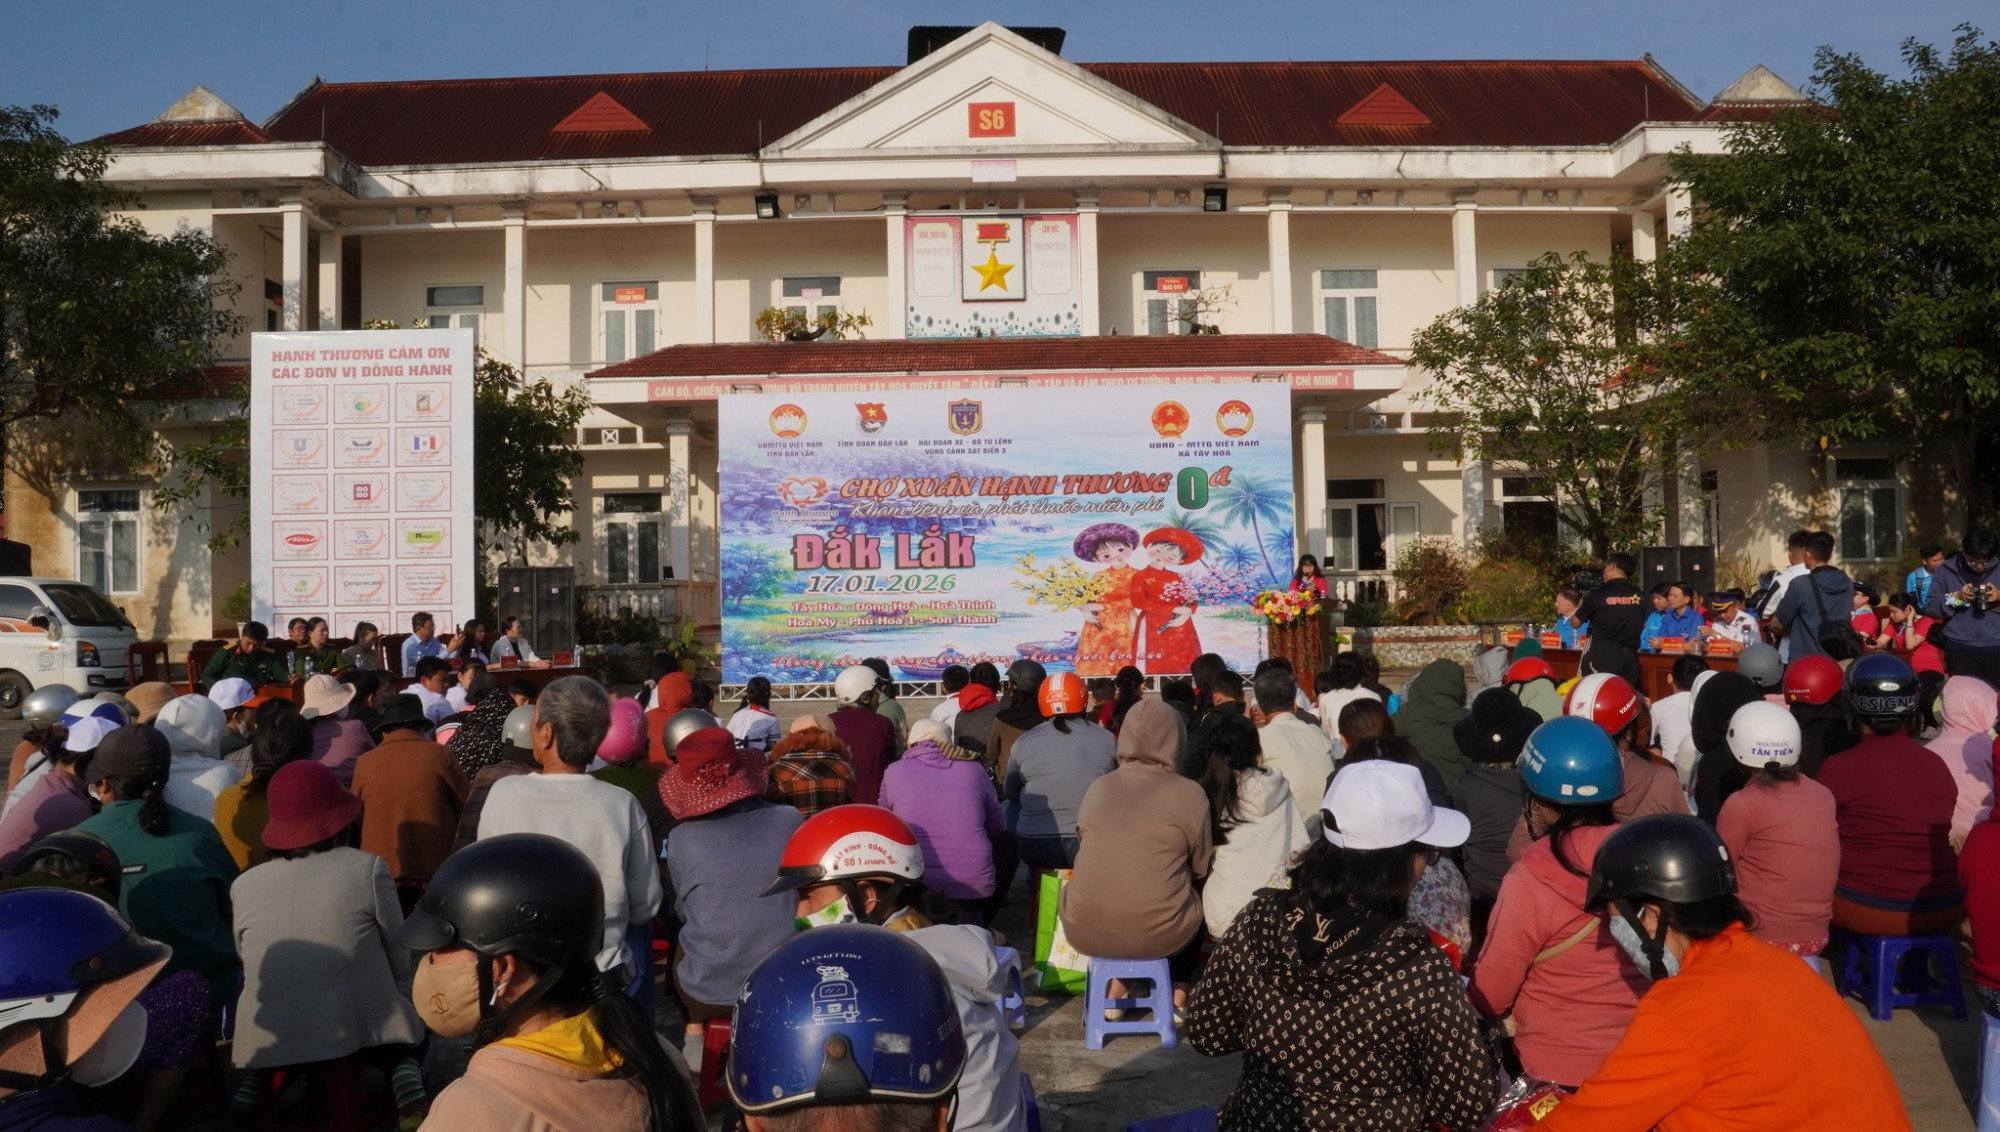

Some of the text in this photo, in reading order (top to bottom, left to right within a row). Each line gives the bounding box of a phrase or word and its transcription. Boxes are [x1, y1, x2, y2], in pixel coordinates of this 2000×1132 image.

[979, 109, 1005, 130] S6
[272, 351, 315, 364] HẠNH
[320, 349, 384, 361] THƯƠNG
[389, 345, 423, 359] CẢM
[272, 362, 453, 379] CÁC ĐƠN VỊ ĐỒNG HÀNH
[655, 386, 674, 398] CÁN
[1296, 373, 1311, 386] CHÍ
[1216, 440, 1234, 448] VIỆT
[840, 476, 900, 502] CHỢ
[900, 472, 978, 498] XUÂN
[978, 474, 1058, 501] HẠNH
[1061, 471, 1173, 496] THƯƠNG
[850, 496, 1165, 520] Khám bệnh và phát thuốc miễn phí
[790, 522, 975, 570] Đắk Lắk
[804, 574, 957, 594] 17.01.2026
[793, 602, 816, 612] Tây
[856, 602, 888, 614] Đông
[960, 600, 996, 612] Thịnh
[907, 616, 914, 625] 1
[928, 615, 952, 625] Sơn
[957, 614, 998, 624] Thành
[772, 656, 826, 672] Thương
[1751, 746, 1794, 756] TÂN TIẾN
[858, 857, 862, 866] 1
